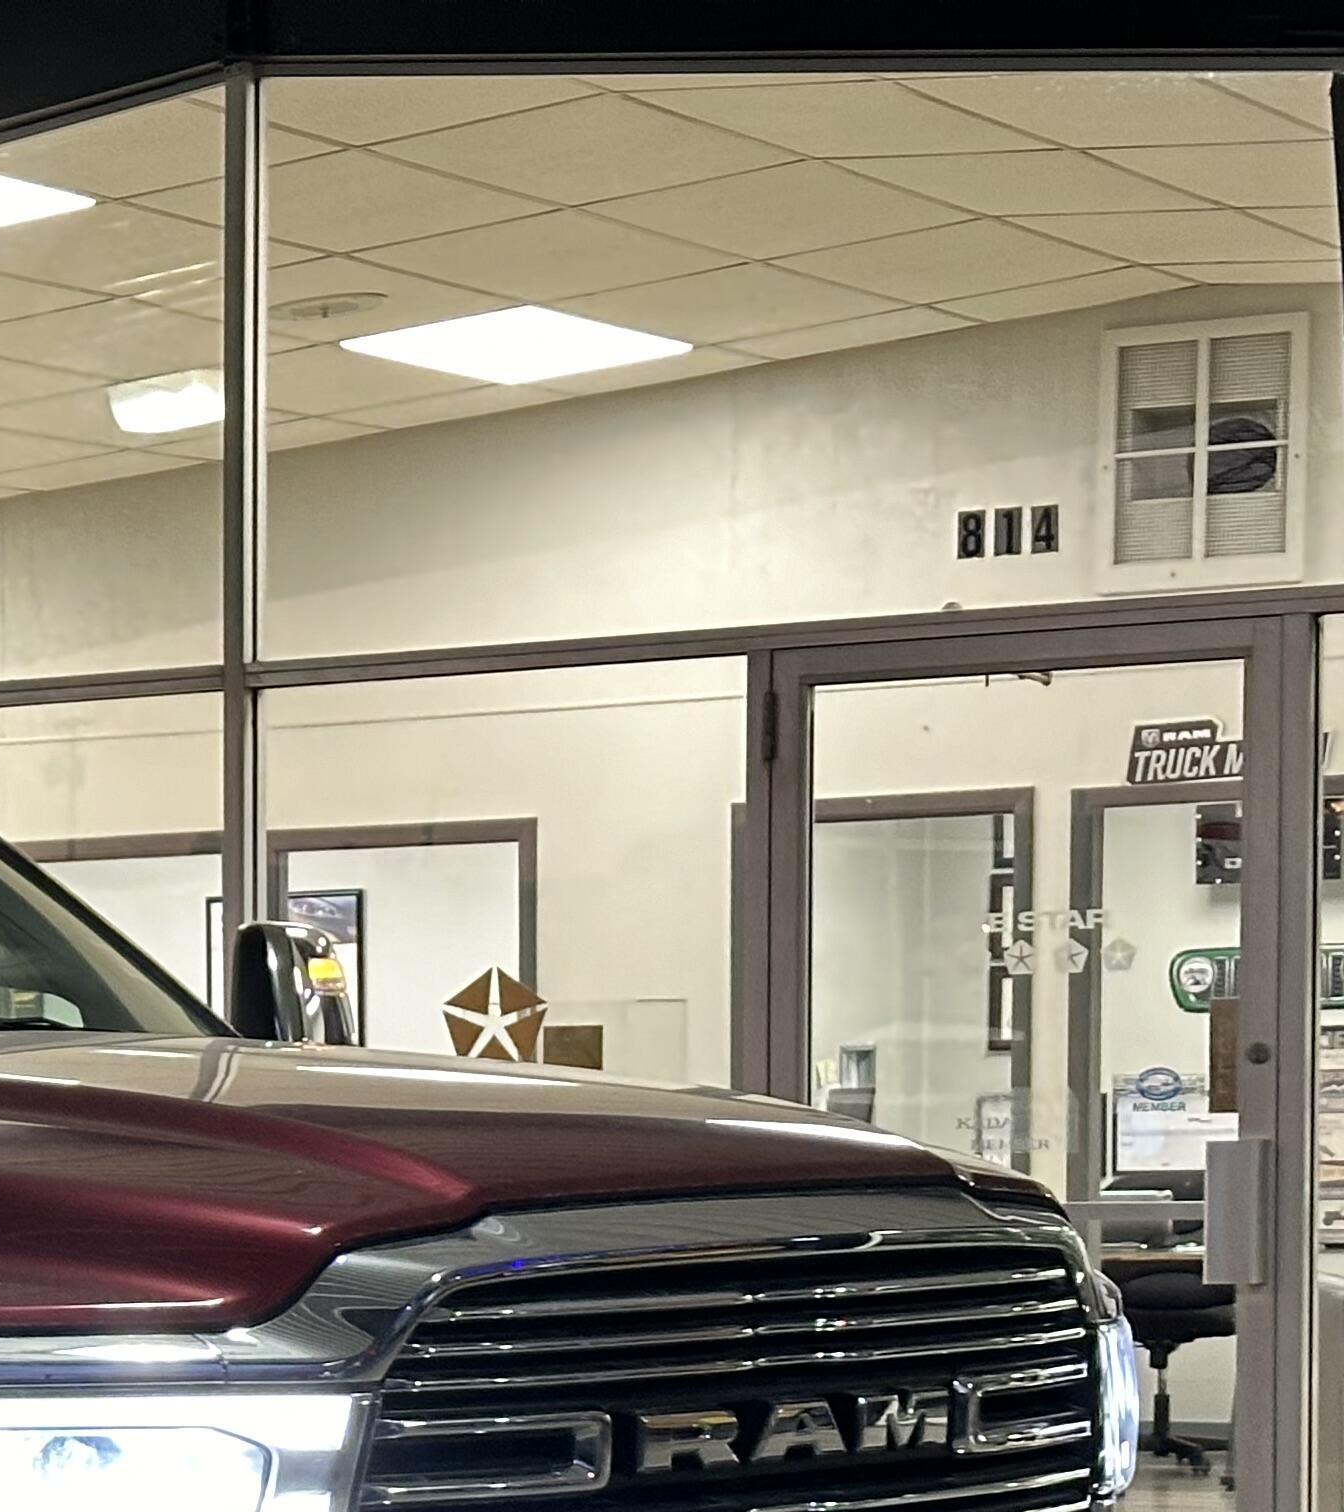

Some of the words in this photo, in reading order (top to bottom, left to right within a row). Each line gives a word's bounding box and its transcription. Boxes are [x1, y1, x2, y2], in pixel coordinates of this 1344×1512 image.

[960, 507, 1056, 557] 814
[1163, 729, 1211, 741] RAM
[1134, 744, 1220, 782] TRUCK
[1132, 1102, 1186, 1112] MEMBER
[637, 1388, 949, 1472] RAM
